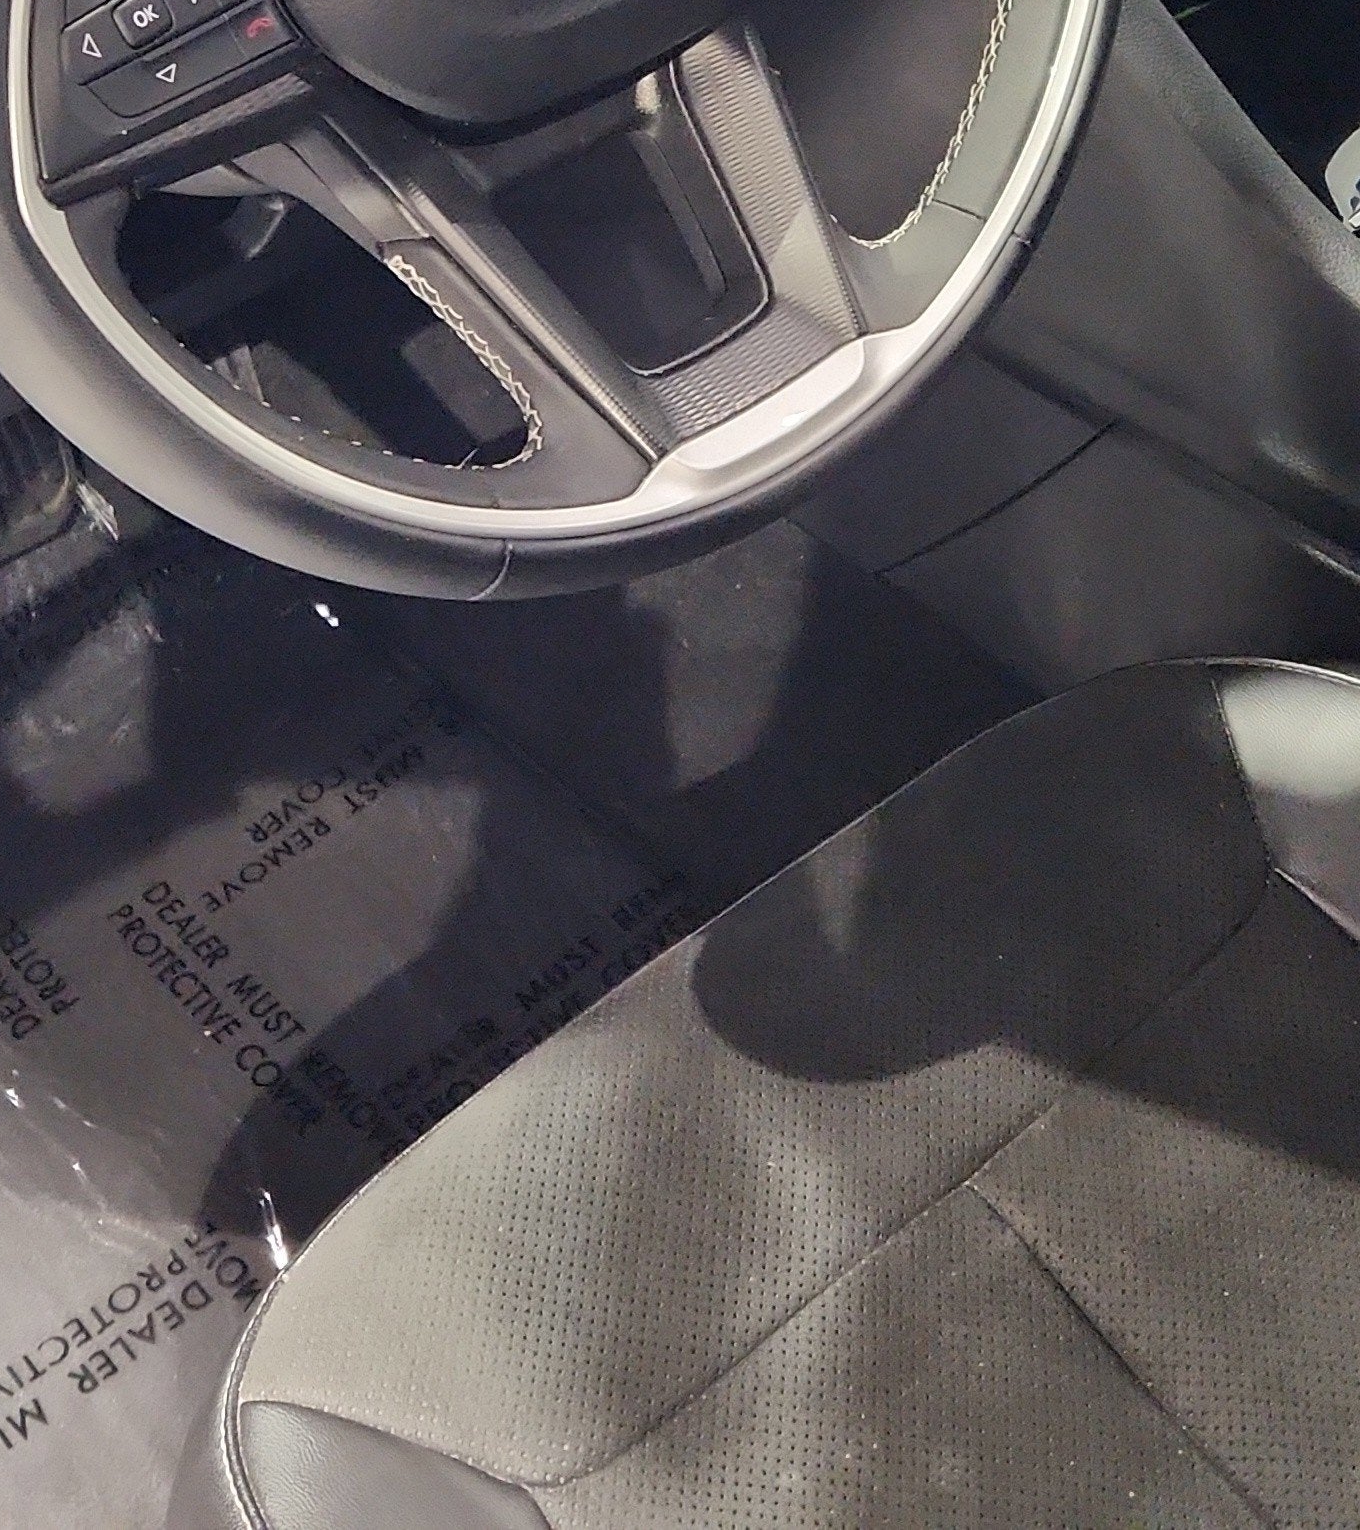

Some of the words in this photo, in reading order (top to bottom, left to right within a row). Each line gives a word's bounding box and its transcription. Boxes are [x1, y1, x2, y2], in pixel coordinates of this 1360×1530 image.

[132, 4, 160, 28] OK
[245, 767, 347, 843] COVER
[199, 816, 331, 913] REMOVE
[107, 903, 242, 1045] PROTECTIVE
[142, 881, 230, 969] DEALER
[227, 973, 306, 1045] MUST
[67, 1279, 216, 1395] DEALER
